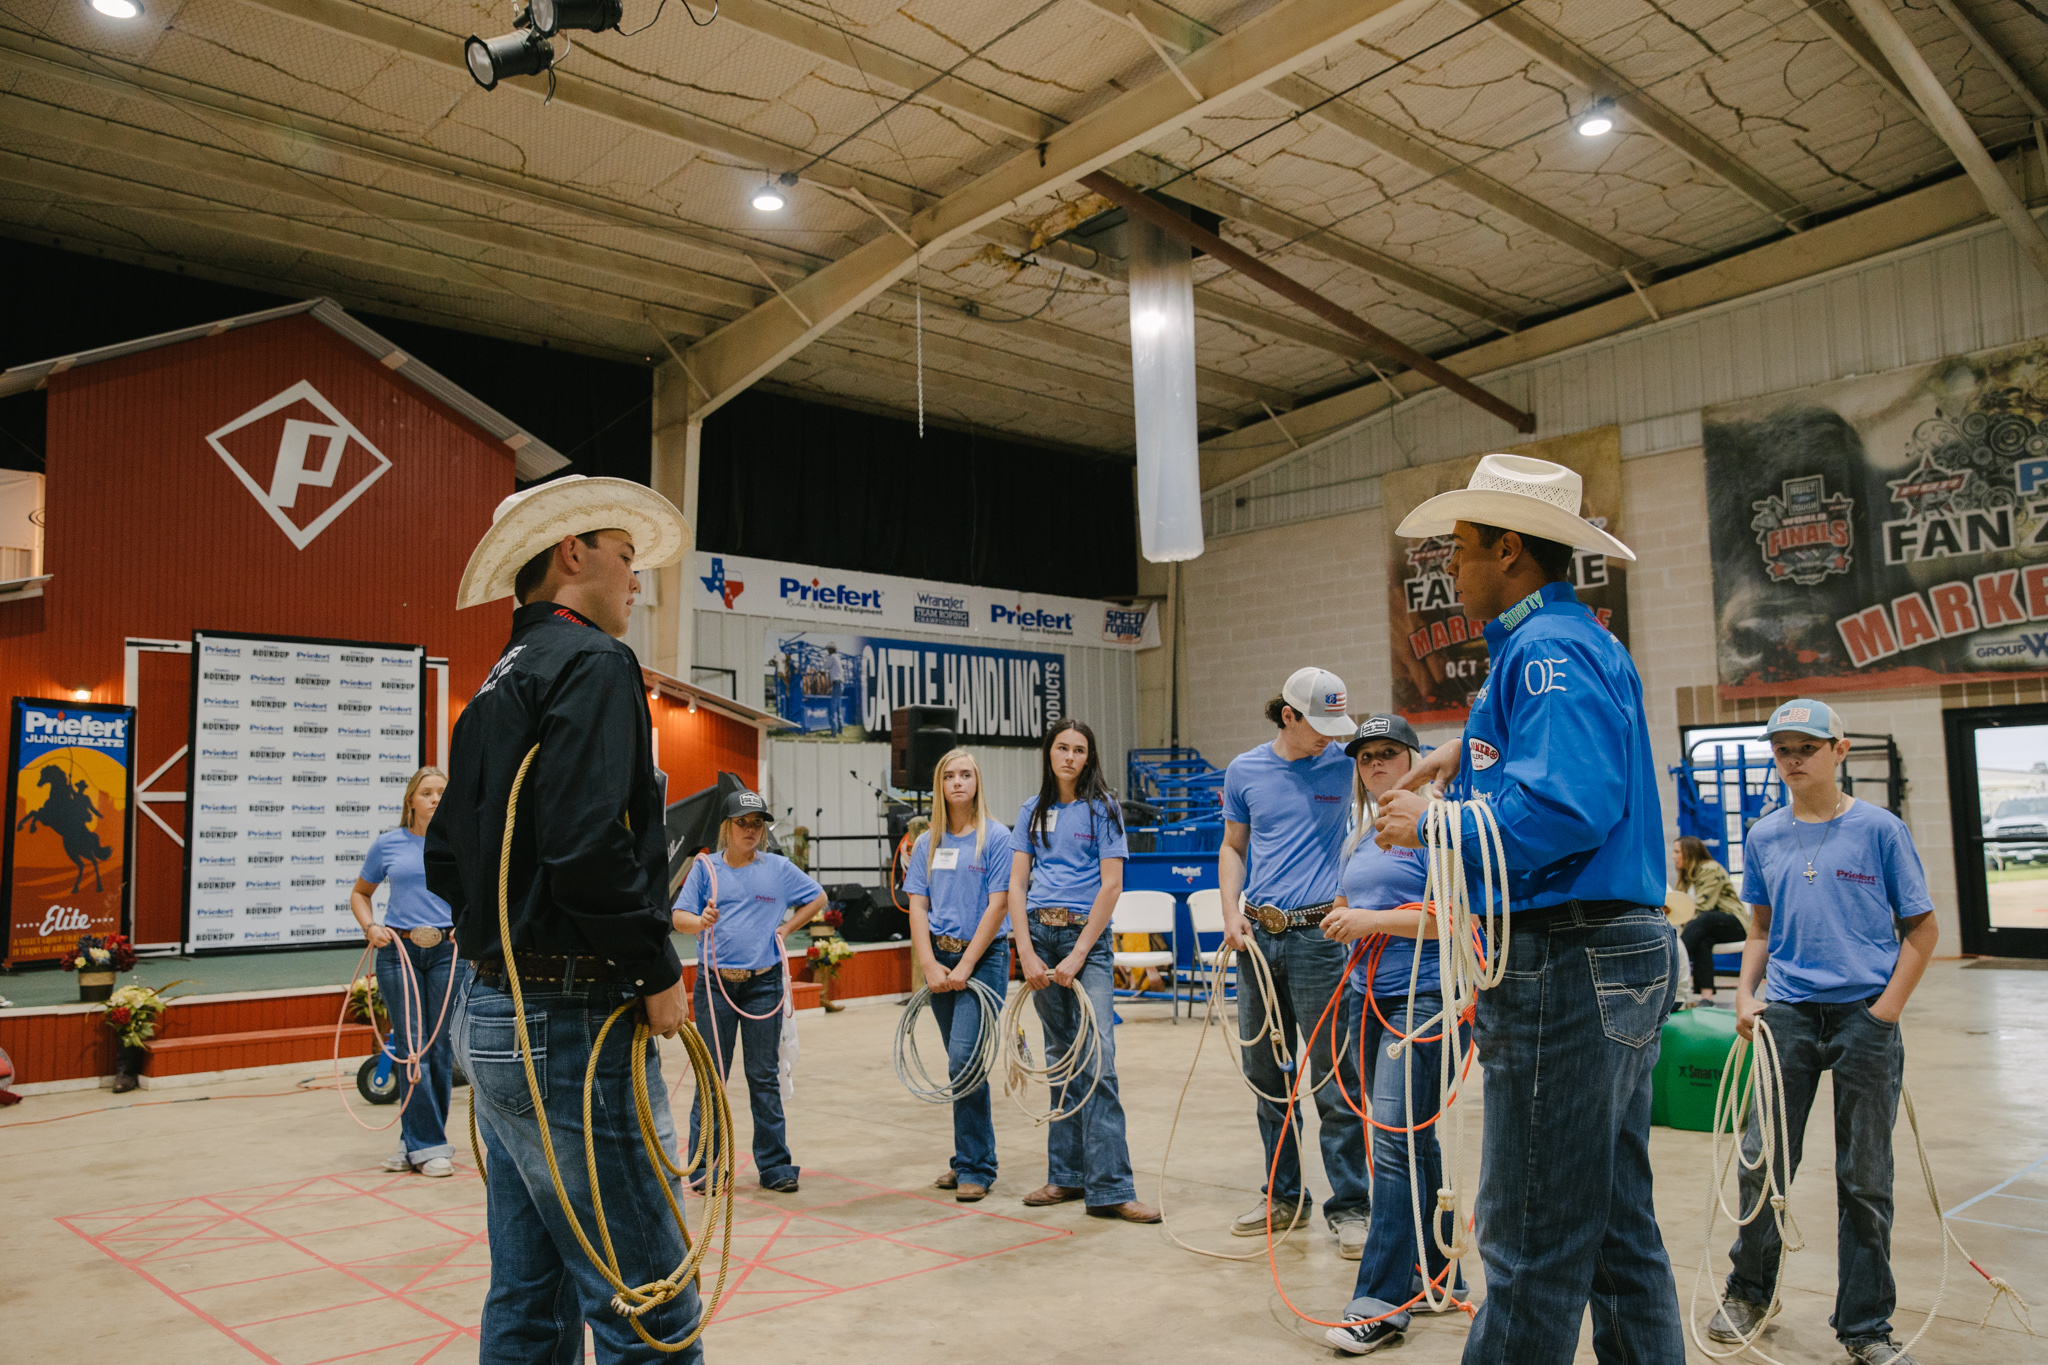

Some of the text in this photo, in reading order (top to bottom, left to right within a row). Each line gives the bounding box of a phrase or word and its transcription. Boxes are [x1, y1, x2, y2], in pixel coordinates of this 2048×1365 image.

[1768, 520, 1848, 557] FINALS
[1883, 507, 2014, 565] FAN
[780, 577, 882, 609] Priefert
[916, 592, 964, 611] Wrangler
[1404, 573, 1459, 612] FA
[818, 603, 842, 612] Ranch
[844, 605, 883, 616] Equipment
[916, 608, 967, 620] TEAM ROPING
[990, 604, 1073, 630] Priefert
[1106, 610, 1145, 625] SPEED
[1499, 590, 1544, 631] Smarty
[1105, 623, 1142, 638] roping
[1976, 643, 2027, 658] GROUP
[1445, 659, 1477, 679] OCT
[943, 653, 1042, 739] HANDLING
[25, 711, 125, 738] Priefert
[25, 734, 125, 748] JUNIOR ELITE
[1836, 869, 1876, 882] Priefert
[39, 904, 91, 937] Elite
